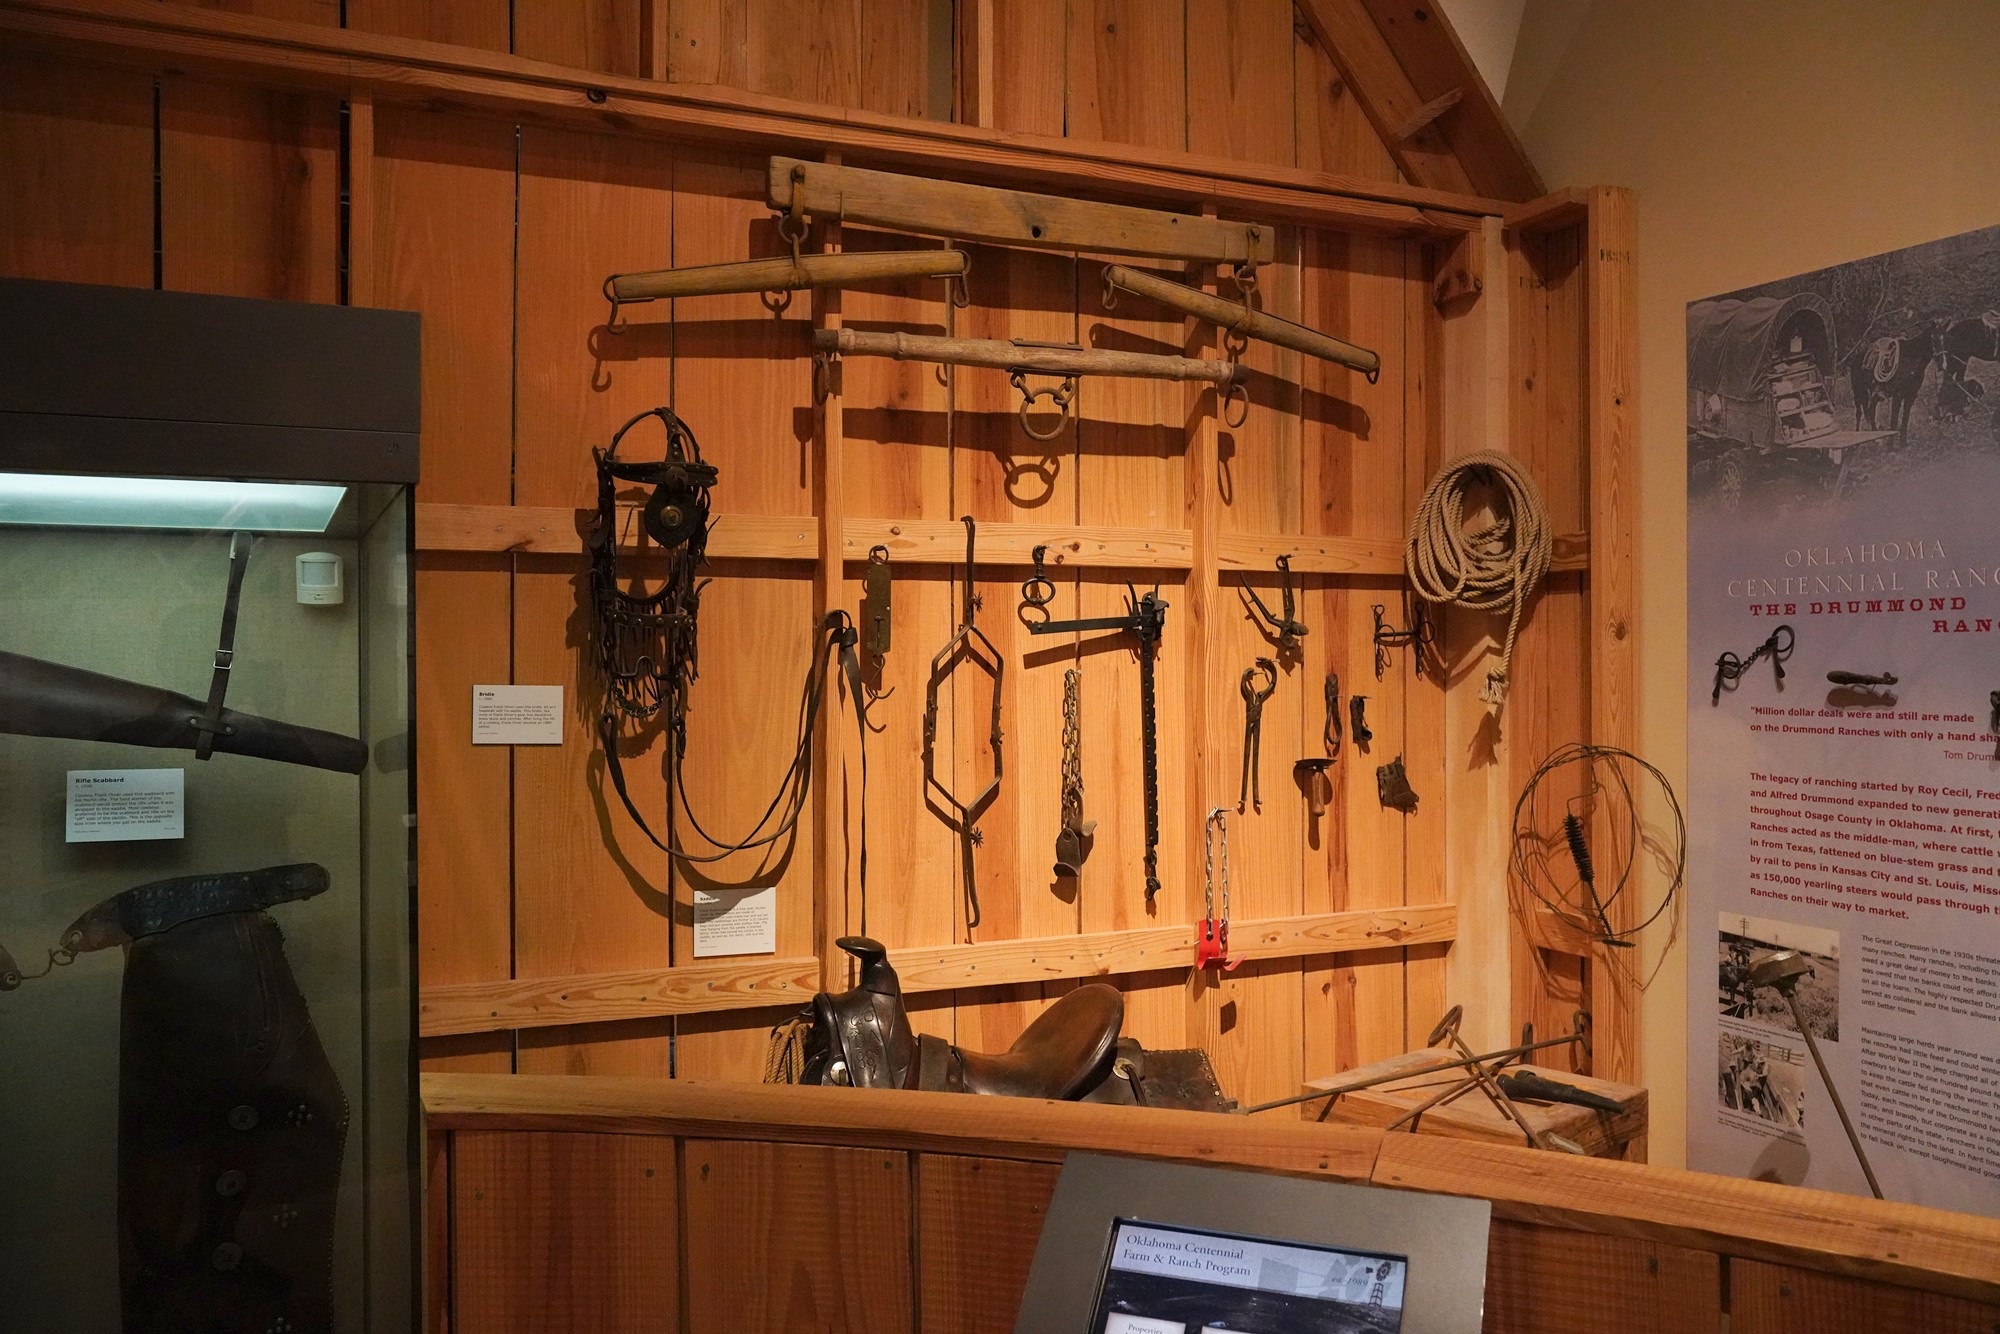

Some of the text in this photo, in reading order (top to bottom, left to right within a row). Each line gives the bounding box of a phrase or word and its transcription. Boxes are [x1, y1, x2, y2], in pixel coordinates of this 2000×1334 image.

[1784, 539, 1947, 567] OKLAHOMA
[1727, 571, 1904, 598] CENTENNIAL
[1749, 596, 1967, 616] THE DRUMMOND
[1932, 618, 2000, 633] RAN
[1751, 707, 1785, 716] "Million
[1788, 708, 1815, 717] dollar
[1818, 708, 1844, 717] deals
[1847, 710, 1873, 719] were
[1875, 710, 1895, 720] and
[1898, 712, 1918, 720] still
[1943, 714, 1975, 722] made
[1764, 724, 1780, 732] the
[1782, 725, 1835, 734] Drummond
[1838, 727, 1880, 737] Ranches
[1884, 729, 1907, 738] with
[1910, 730, 1934, 741] only
[1937, 732, 1944, 740] a
[1947, 732, 1976, 741] hand
[1944, 750, 1964, 759] Tom
[1751, 772, 1767, 781] The
[1769, 774, 1799, 785] legacy
[1802, 776, 1812, 784] of
[1815, 779, 1858, 790] ranching
[1861, 782, 1898, 792] started
[1901, 783, 1914, 795] by
[1918, 785, 1938, 797] Roy
[1942, 787, 1972, 799] Cecil,
[1750, 790, 1767, 798] and
[1770, 790, 1798, 800] Alfred
[1801, 793, 1855, 806] Drummond
[1857, 800, 1908, 810] expanded
[1911, 803, 1923, 812] to
[1926, 806, 1950, 814] new
[1750, 806, 1994, 839] throughout Osage County in Oklahoma. At first,
[1750, 822, 1994, 857] Ranches acted as the middle-man, where cattle
[1750, 838, 1994, 876] in from Texas, fattened on blue-stem grass and
[1750, 854, 1761, 865] by
[1764, 857, 1779, 865] rail
[1782, 859, 1792, 867] to
[1794, 862, 1817, 871] pens
[1819, 863, 1829, 872] in
[1832, 865, 1868, 877] Kansas
[1870, 870, 1891, 882] City
[1894, 875, 1914, 884] and
[1917, 876, 1932, 886] St.
[1936, 879, 1968, 893] Louis,
[1750, 872, 1990, 914] as 150,000 yearling steers would pass through
[1750, 887, 1909, 919] Ranches on their way to market.
[1880, 950, 1907, 958] ranches.
[1909, 954, 1926, 963] Many
[1928, 959, 1956, 968] ranches,
[1958, 964, 1990, 975] including
[1894, 941, 1930, 951] Depression
[1954, 951, 1974, 960] 1930s
[1928, 970, 1951, 979] money
[1892, 984, 1911, 992] loans.
[1927, 991, 1948, 1000] highly
[1950, 996, 1983, 1007] respected
[1921, 979, 1941, 987] banks
[1976, 990, 1997, 998] afford
[1861, 989, 1882, 997] served
[1893, 996, 1922, 1005] collateral
[1970, 1011, 1996, 1021] allowed
[1877, 1002, 1896, 1010] better
[1897, 1007, 1918, 1015] times.
[1126, 1234, 1244, 1260] Oklahoma Centennial
[1122, 1249, 1251, 1278] Farm & Ranch Program
[1346, 1277, 1369, 1287] 1989
[1127, 1323, 1163, 1334] Properties
